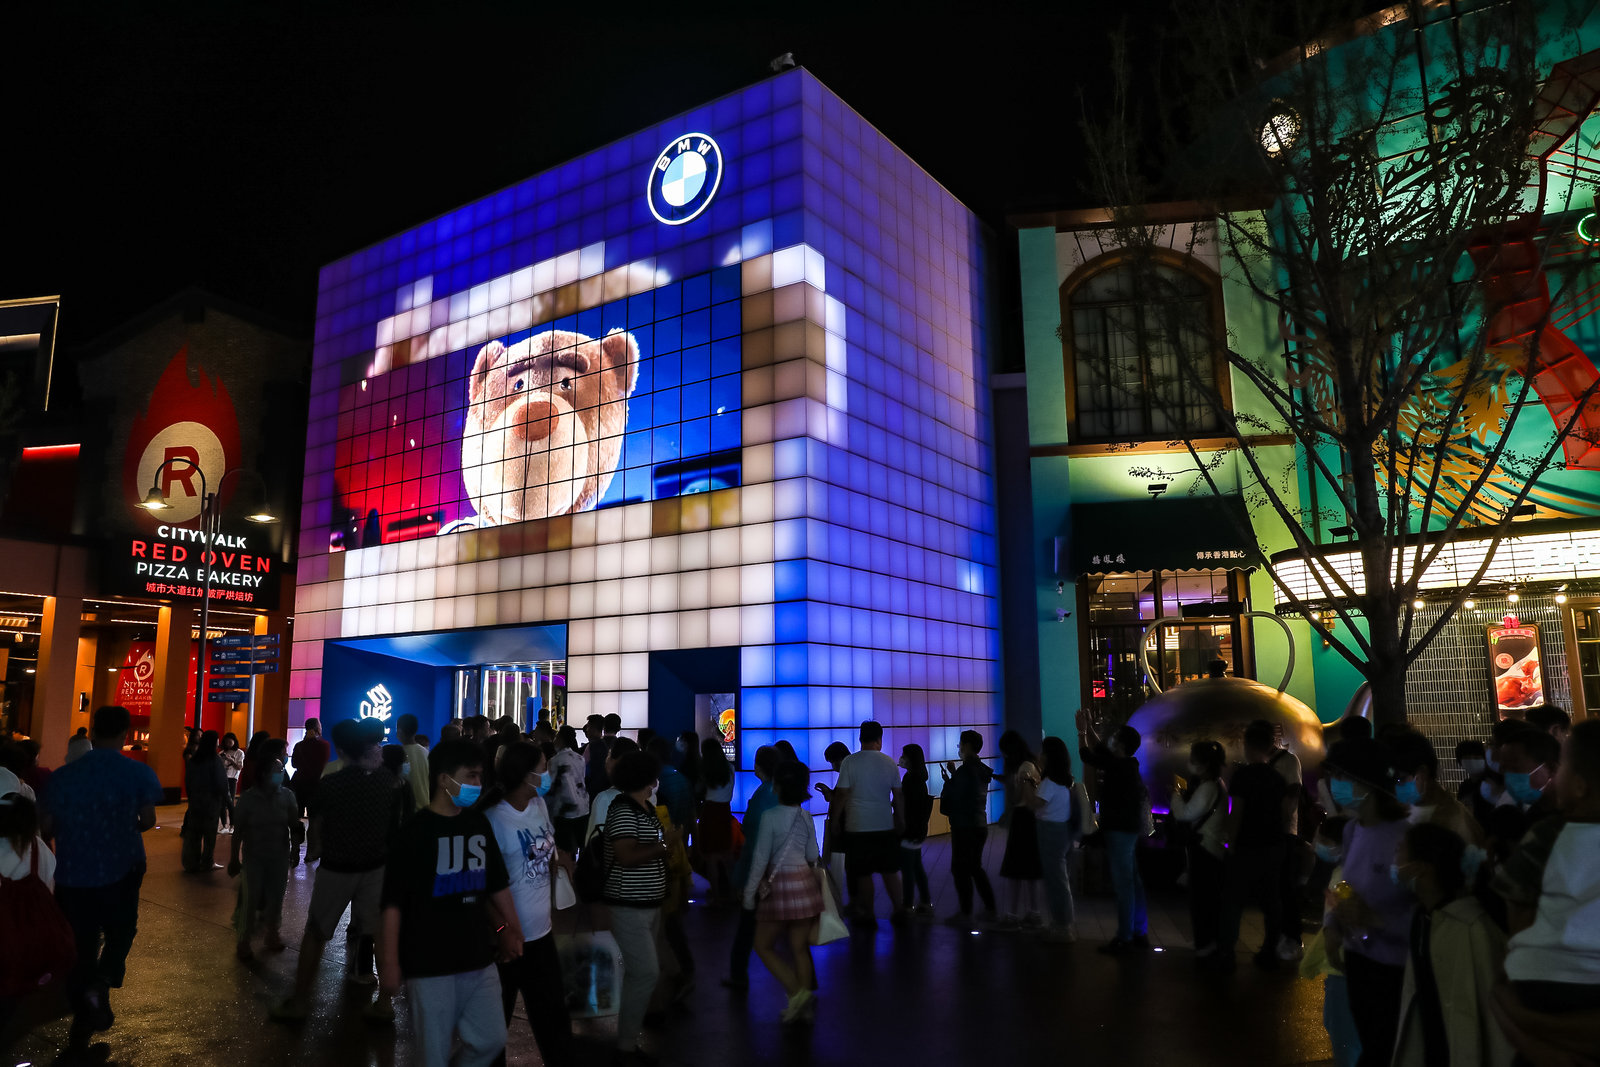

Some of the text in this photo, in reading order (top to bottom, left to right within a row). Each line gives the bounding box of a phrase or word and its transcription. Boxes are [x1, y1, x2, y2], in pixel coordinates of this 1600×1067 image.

[657, 138, 712, 172] BMW
[161, 446, 200, 498] R
[157, 525, 247, 549] CITYWALK
[131, 540, 271, 573] RED OVEN
[136, 562, 263, 588] PIZZA BAKERY
